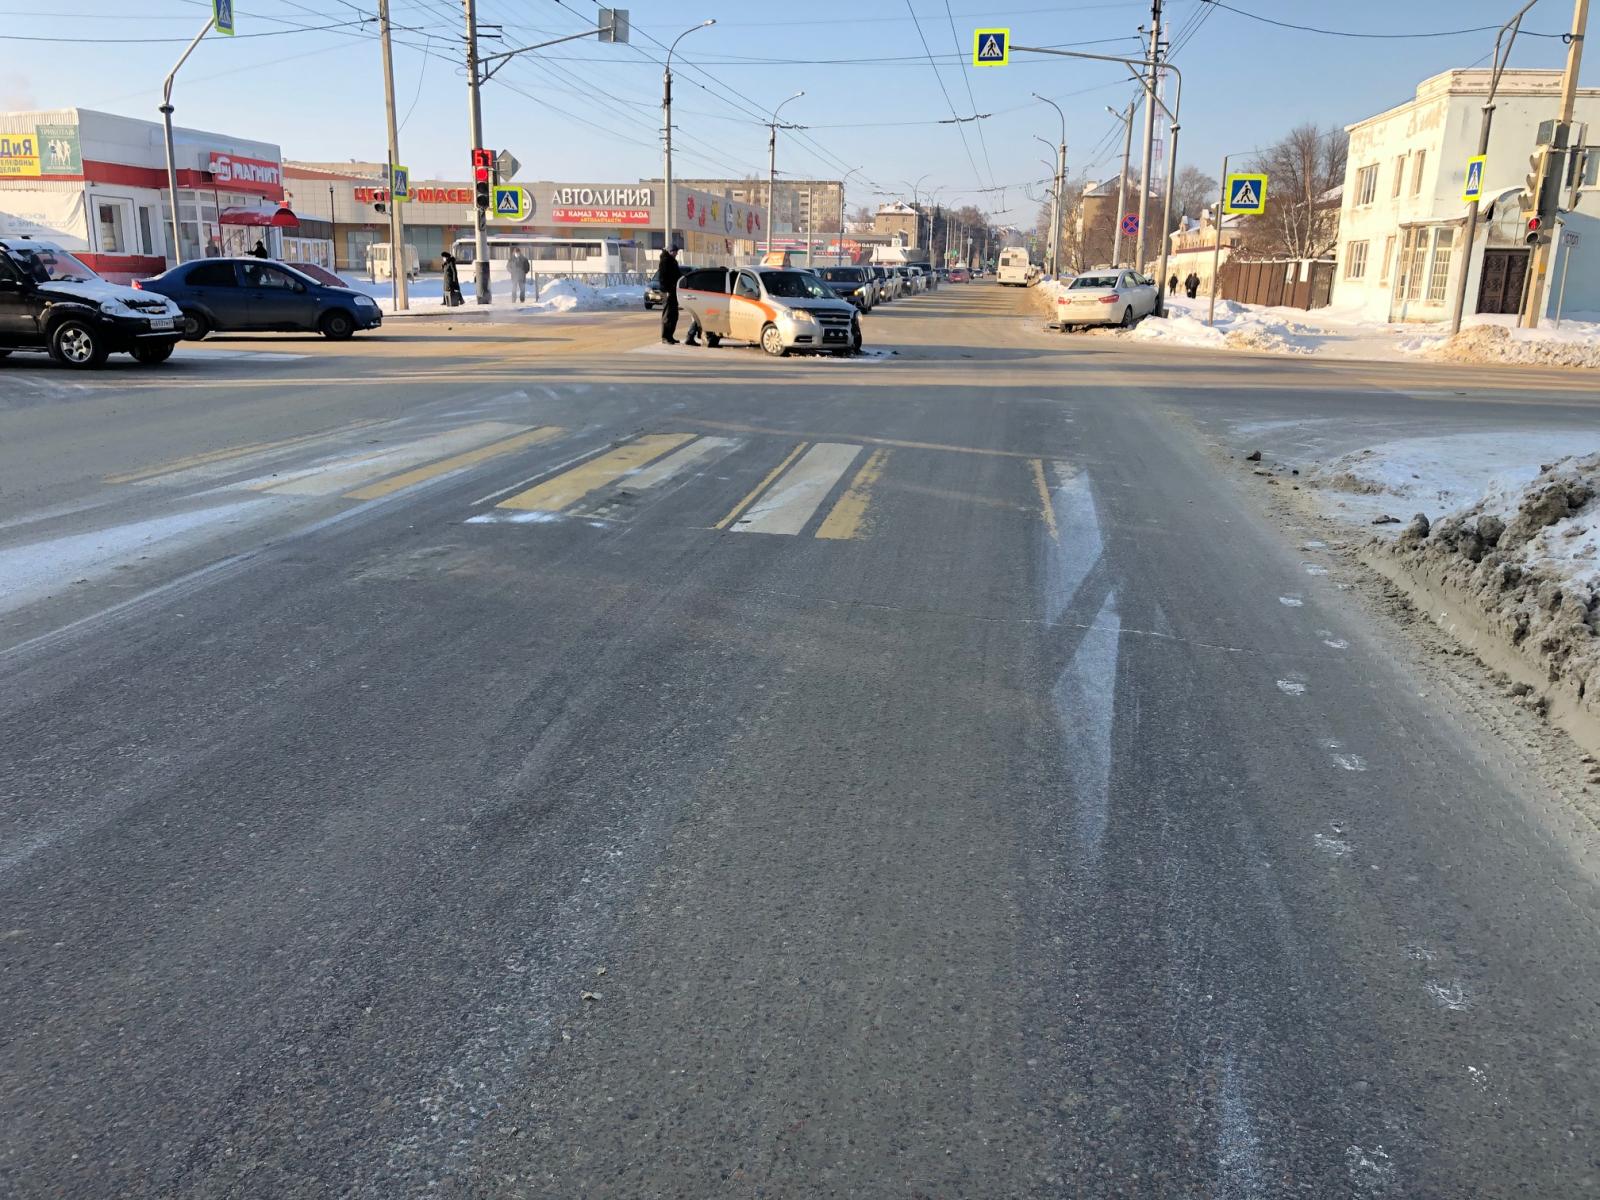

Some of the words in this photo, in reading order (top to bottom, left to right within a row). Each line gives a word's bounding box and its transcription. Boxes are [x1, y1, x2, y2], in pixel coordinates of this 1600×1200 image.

[232, 162, 279, 184] МАГНИТ
[552, 188, 651, 206] АВТОЛИНИЯ
[568, 210, 592, 218] КАМАЗ
[630, 211, 649, 219] LADA
